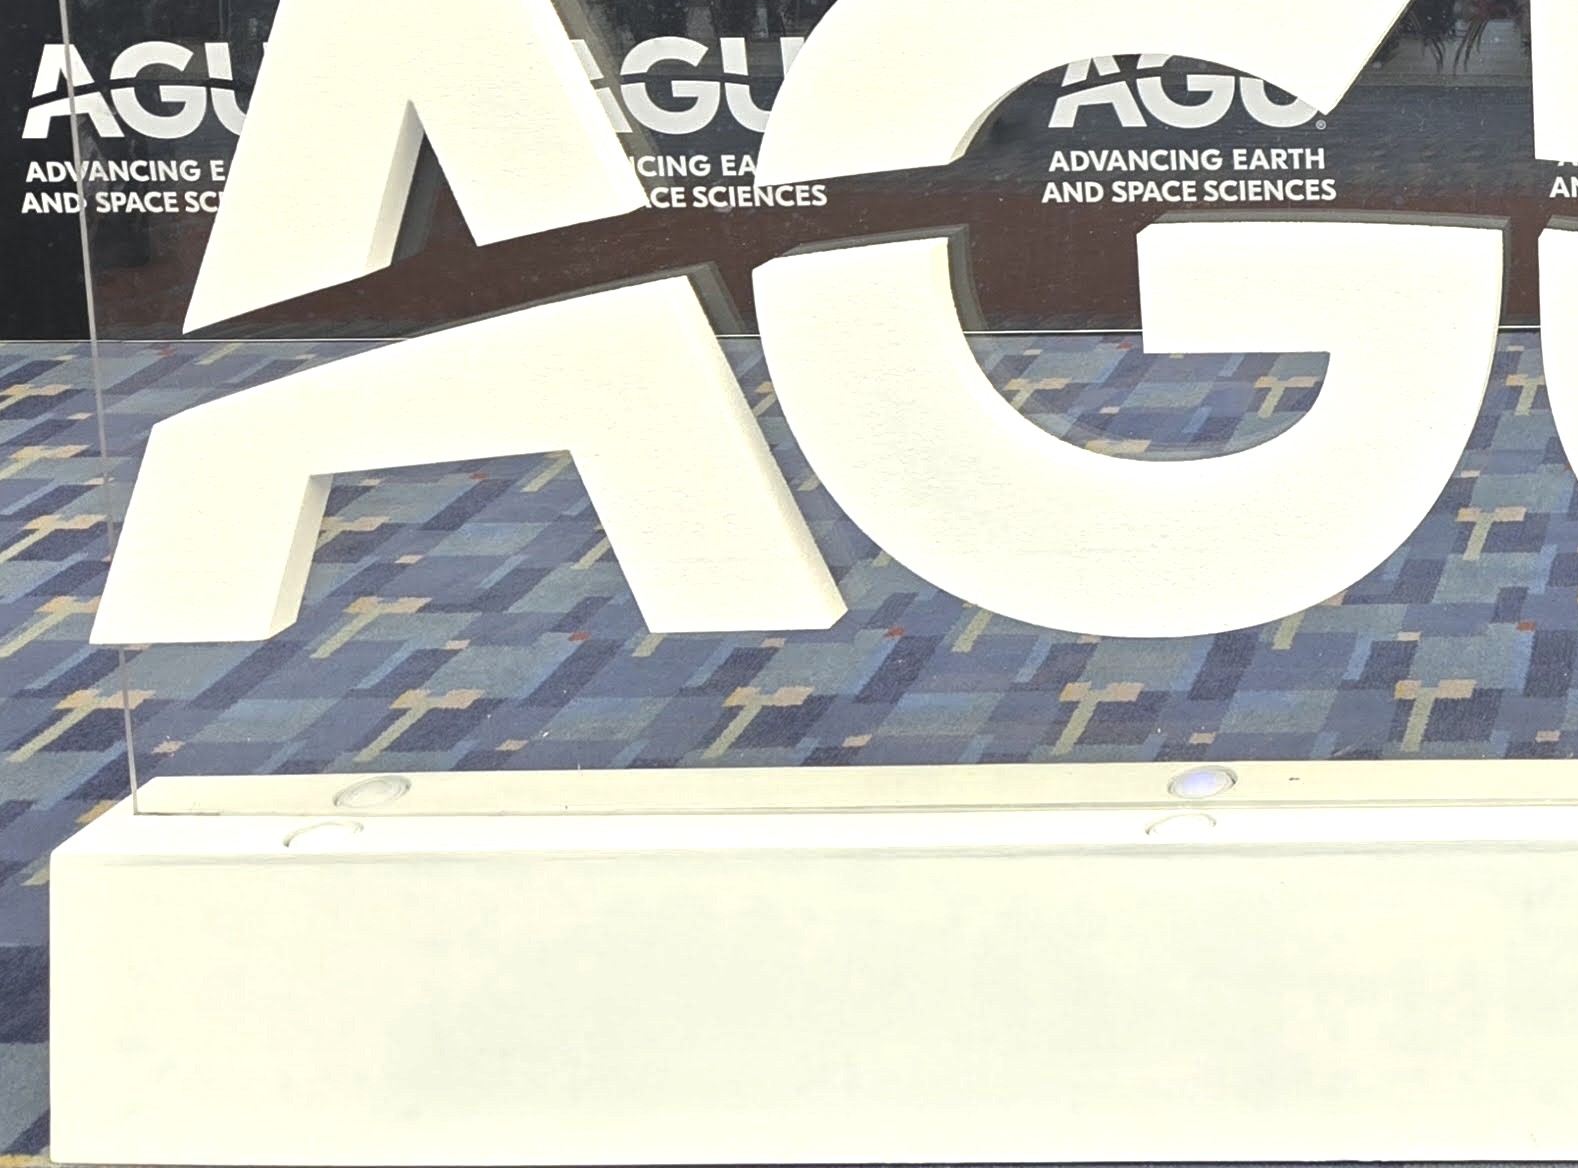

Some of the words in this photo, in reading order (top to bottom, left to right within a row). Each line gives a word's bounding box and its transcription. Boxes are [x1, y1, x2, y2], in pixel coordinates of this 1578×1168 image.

[26, 160, 201, 182] ADVANCING
[1049, 149, 1223, 172] ADVANCING
[1233, 148, 1324, 170] EARTH
[693, 185, 828, 208] SCIENCES
[1042, 182, 1104, 203] AND
[1112, 181, 1197, 202] SPACE
[1204, 179, 1336, 201] SCIENCES
[22, 192, 86, 214] AND
[96, 192, 179, 213] SPACE
